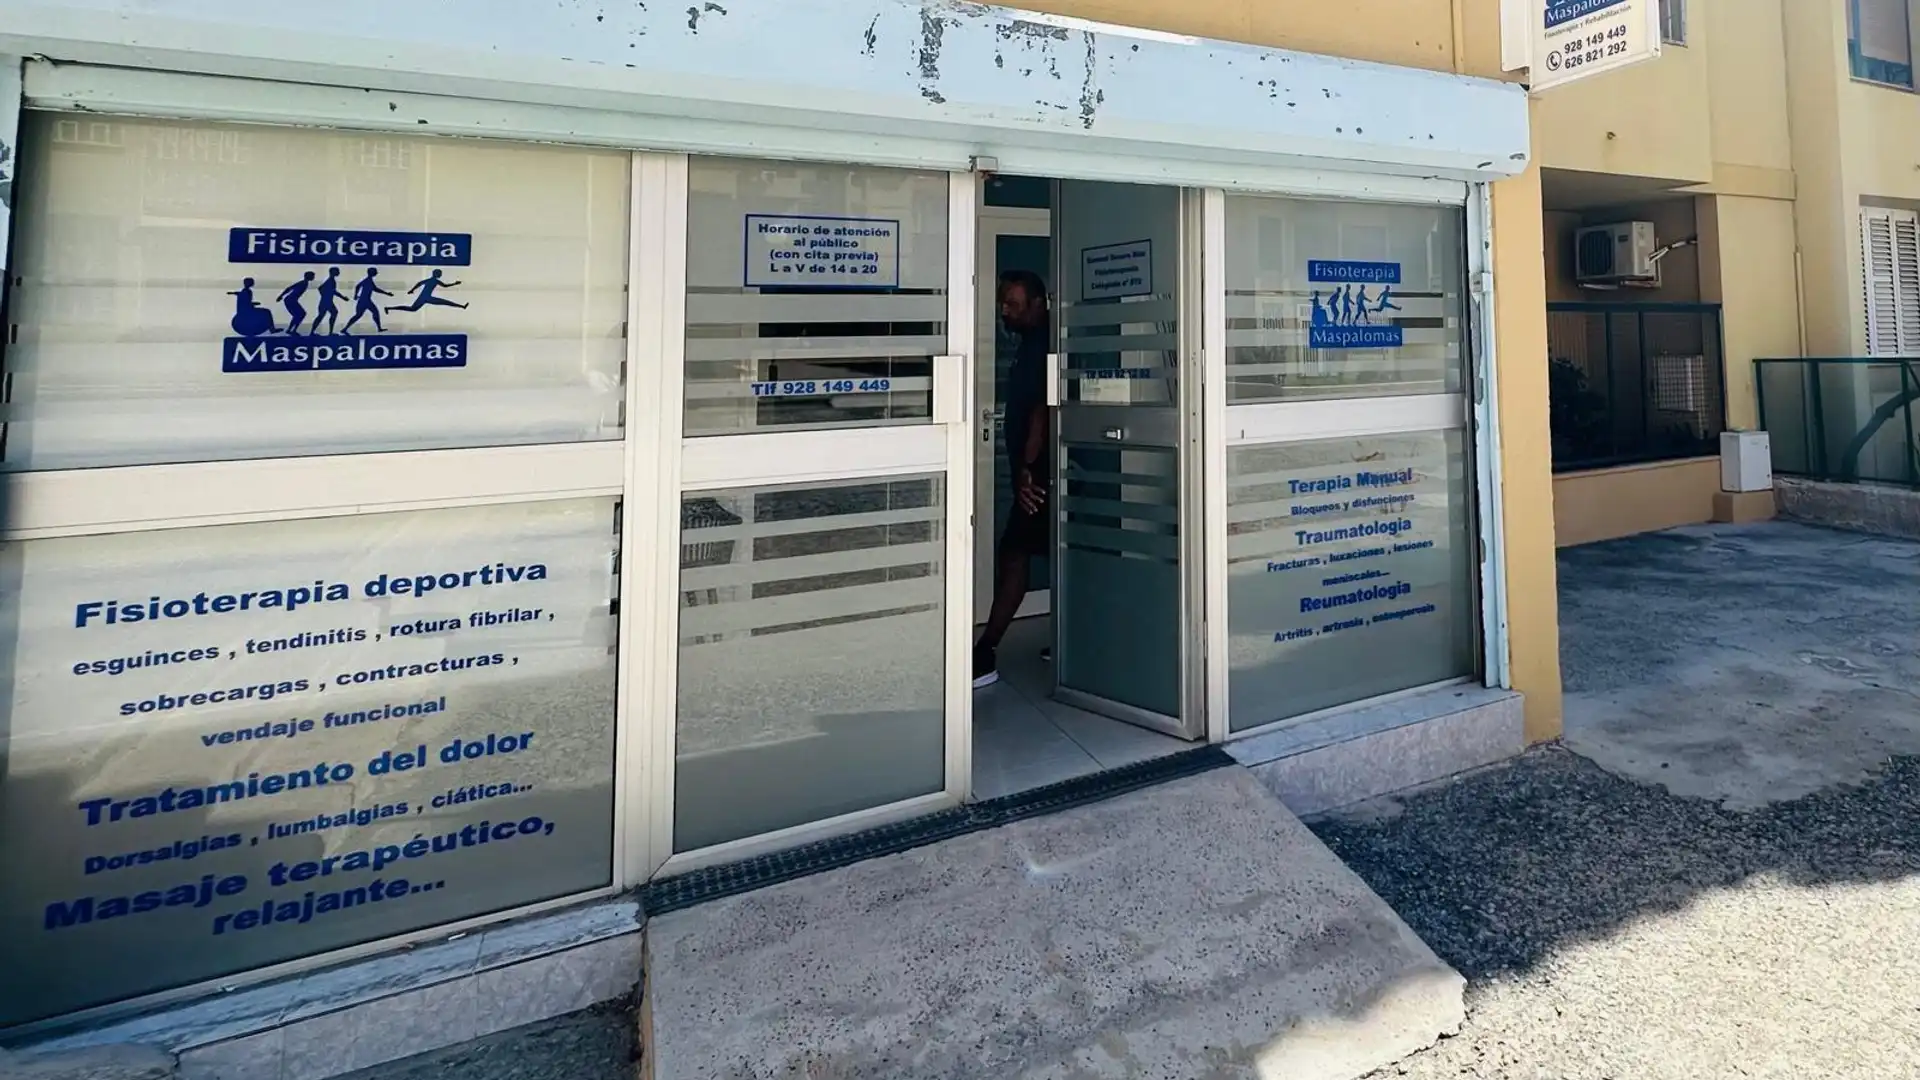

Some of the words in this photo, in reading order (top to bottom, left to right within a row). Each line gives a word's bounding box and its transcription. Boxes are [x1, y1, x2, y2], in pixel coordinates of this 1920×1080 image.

[1564, 39, 1583, 54] 928
[1586, 32, 1604, 47] 149
[1606, 24, 1627, 40] 449
[1564, 54, 1583, 69] 626
[1586, 48, 1604, 63] 821
[1607, 40, 1627, 56] 292
[758, 223, 810, 235] Horario
[813, 225, 830, 236] de
[833, 226, 891, 237] atención
[793, 238, 806, 247] al
[810, 238, 859, 249] público
[247, 232, 458, 264] Fisioterapia
[769, 249, 800, 260] (con
[804, 250, 830, 260] cita
[834, 250, 879, 262] previa)
[770, 263, 778, 273] L
[783, 265, 791, 273] a
[795, 264, 805, 273] V
[809, 264, 826, 273] de
[830, 264, 846, 273] 14
[850, 265, 858, 274] a
[861, 264, 878, 274] 20
[1314, 263, 1395, 281] Fisioterapia
[1312, 328, 1400, 346] Maspalomas
[232, 338, 460, 369] Maspalomas
[751, 382, 777, 396] Tlf
[783, 381, 816, 395] 928
[822, 380, 854, 393] 149
[859, 379, 890, 391] 449
[1288, 474, 1351, 494] Terapia
[1356, 467, 1412, 488] Manual
[1291, 502, 1341, 516] Bloqueos
[1343, 502, 1349, 512] y
[1352, 493, 1415, 508] disfunciones
[1267, 556, 1320, 573] Fracturas
[1329, 547, 1385, 564] luxaciones
[1394, 539, 1433, 553] lesiones
[75, 580, 349, 628] Fisioterapia
[364, 562, 548, 598] deportiva
[72, 646, 220, 676] esguinces
[245, 628, 367, 655] tendinitis
[390, 618, 461, 638] rotura
[469, 607, 543, 628] fibrilar
[1274, 627, 1314, 643] Artritis
[1322, 617, 1364, 634] artrosis
[119, 678, 309, 716] sobrecargas
[336, 651, 504, 686] contracturas
[201, 717, 315, 747] vendaje
[323, 696, 446, 729] funcional
[78, 761, 354, 827] Tratamiento
[367, 744, 427, 777] del
[440, 731, 534, 764] dolor
[84, 833, 243, 875] Dorsalgias
[268, 800, 409, 840] lumbalgias
[431, 782, 533, 809] ciática...
[44, 874, 248, 931] Masaje
[267, 816, 556, 887] terapéutico,
[212, 878, 446, 936] relajante...
